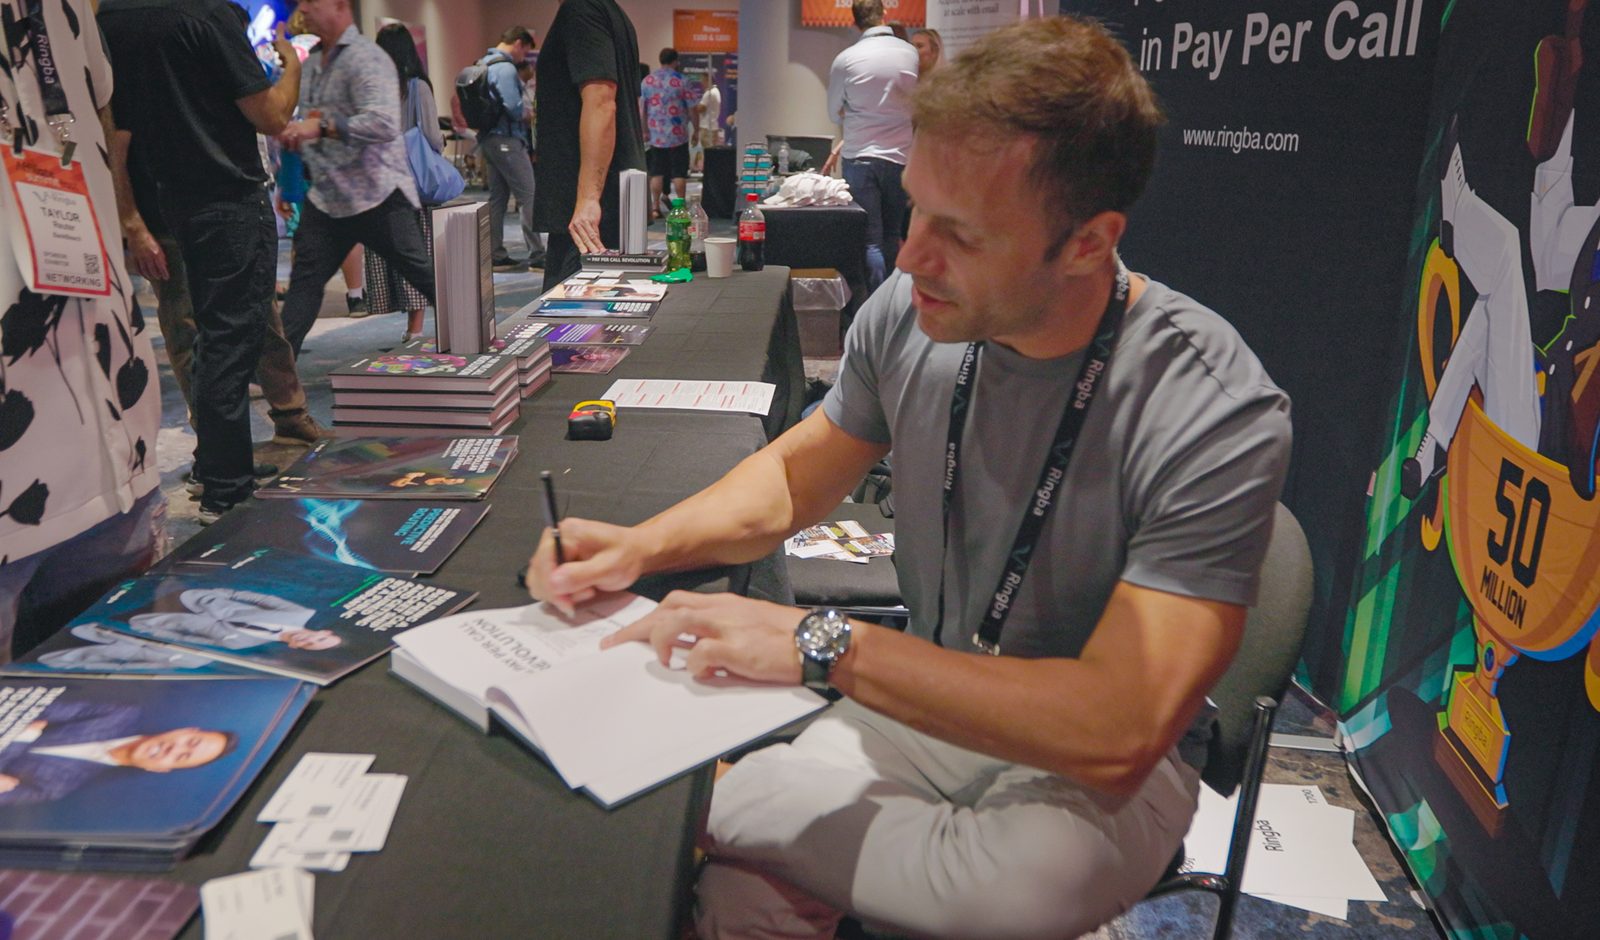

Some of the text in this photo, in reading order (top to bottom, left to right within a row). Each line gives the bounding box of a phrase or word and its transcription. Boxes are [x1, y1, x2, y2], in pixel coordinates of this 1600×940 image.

[967, 4, 980, 15] with
[36, 34, 56, 84] Ringba
[1140, 0, 1423, 81] in Pay Per Call
[1183, 125, 1299, 154] www.ringba.com
[40, 206, 80, 222] TAYLOR
[45, 272, 102, 288] NETWORKING
[1074, 359, 1104, 410] Ringba
[462, 455, 475, 465] CALL
[944, 442, 956, 490] Ringba
[1033, 468, 1062, 518] Ringba
[394, 508, 430, 536] ROUTING
[400, 508, 444, 545] PREDICTIVE
[1486, 457, 1551, 589] 50
[991, 572, 1021, 621] Ringba
[1480, 565, 1527, 630] MILLION
[372, 614, 406, 632] CALL
[459, 621, 527, 673] PAY PER CALL
[1254, 819, 1285, 852] Ringba
